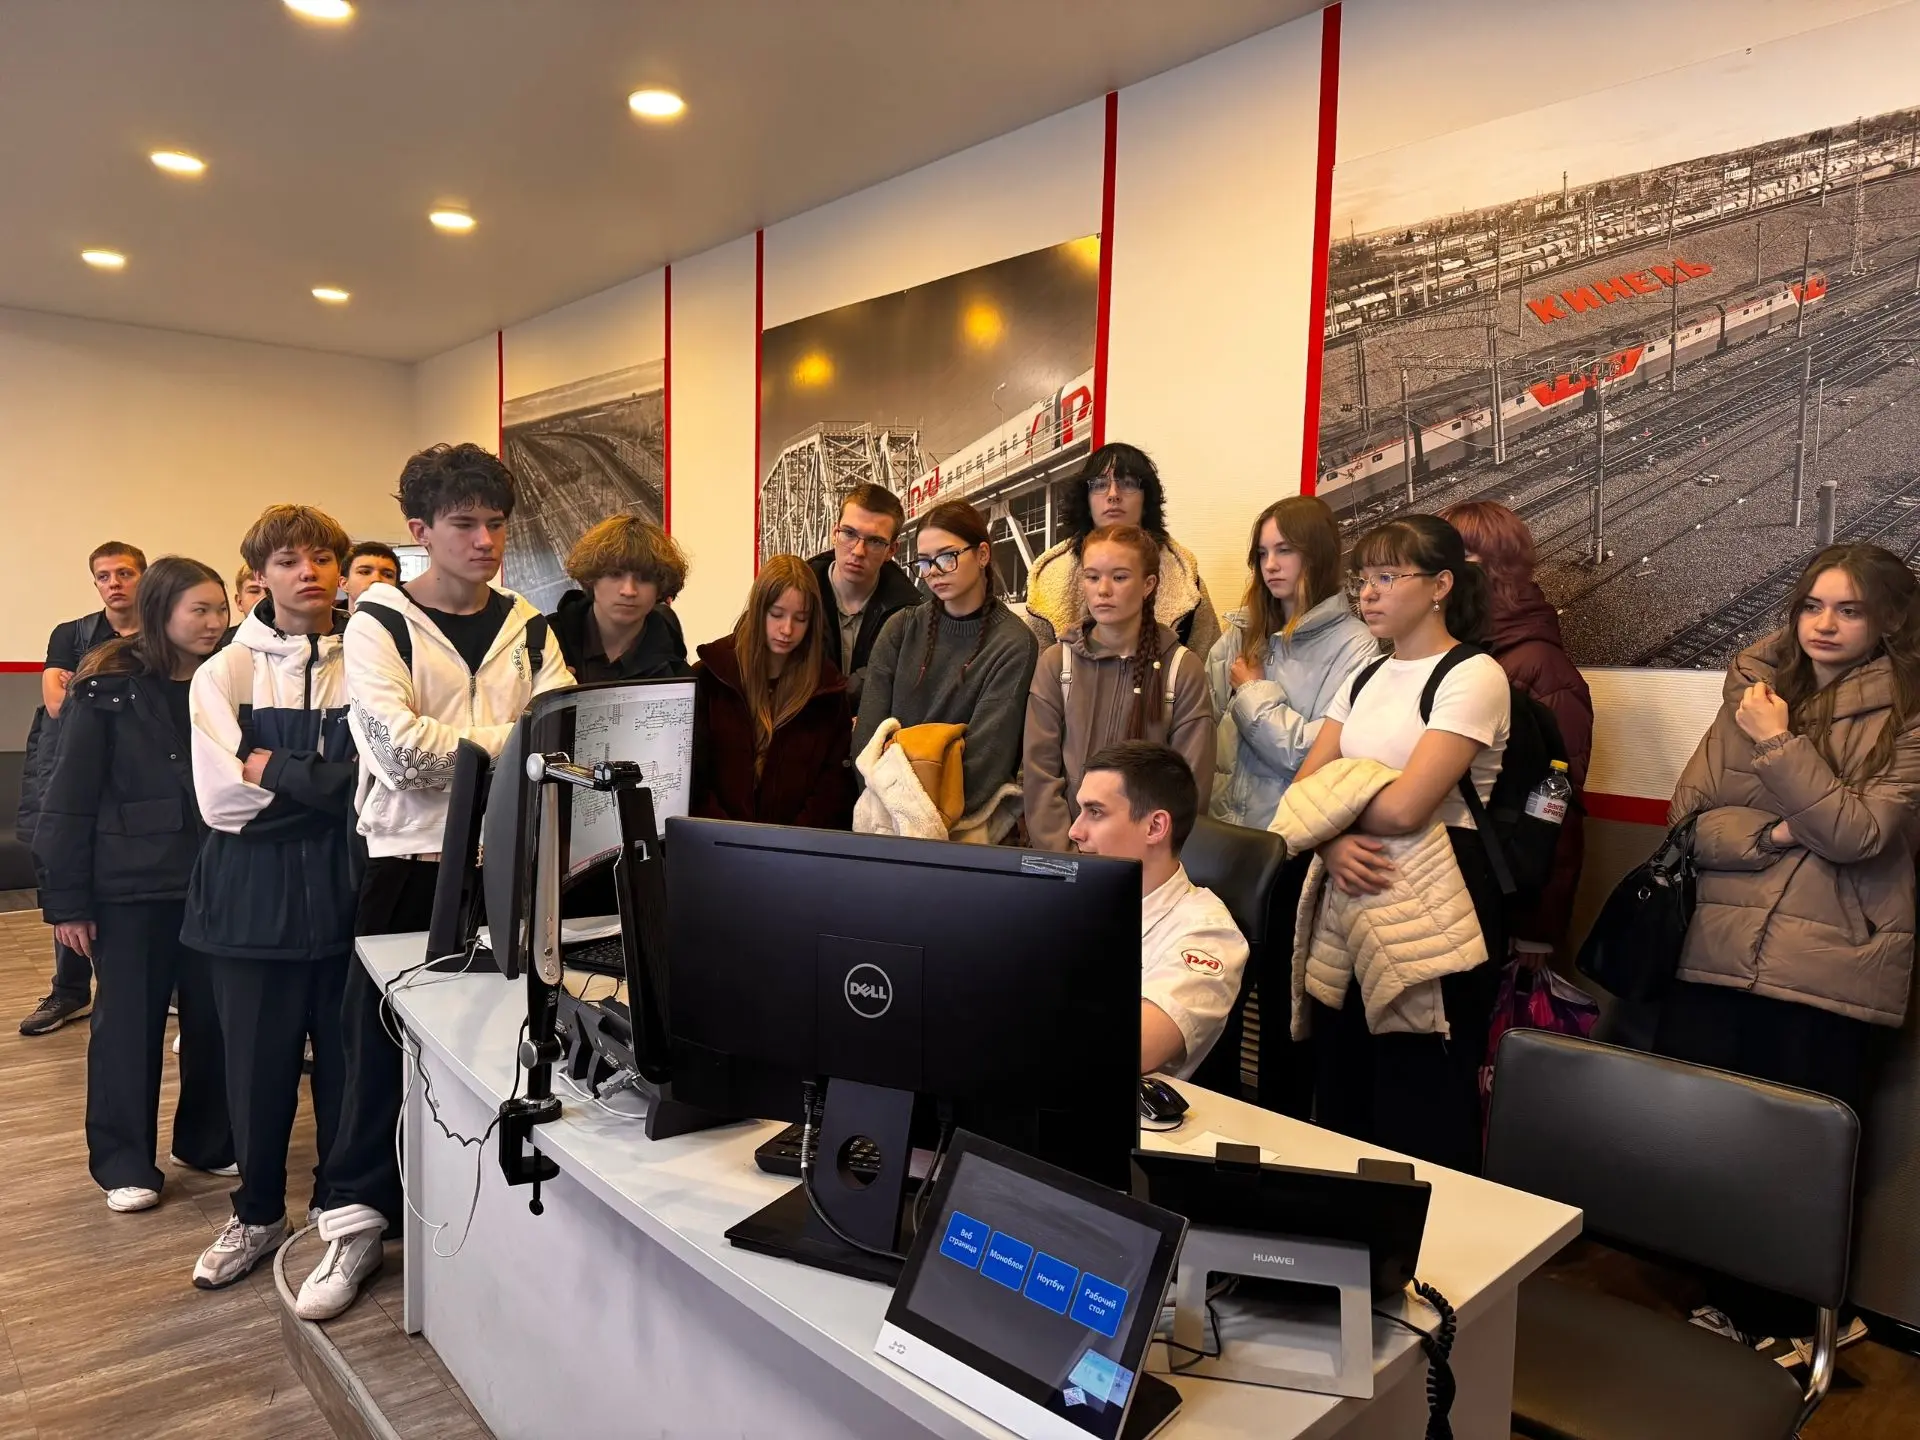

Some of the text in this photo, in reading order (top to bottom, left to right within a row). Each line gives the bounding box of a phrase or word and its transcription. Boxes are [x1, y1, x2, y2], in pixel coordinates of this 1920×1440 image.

[1526, 257, 1712, 324] КИНЕЛЬ
[850, 981, 887, 1000] DELL
[960, 1228, 973, 1240] Веб
[948, 1236, 977, 1254] страница
[989, 1249, 1024, 1271] Моноблок
[1253, 1252, 1295, 1266] HUAWEI
[1036, 1272, 1066, 1293] Ноутбук
[1084, 1288, 1117, 1310] Рабочий
[1088, 1303, 1106, 1316] стол
